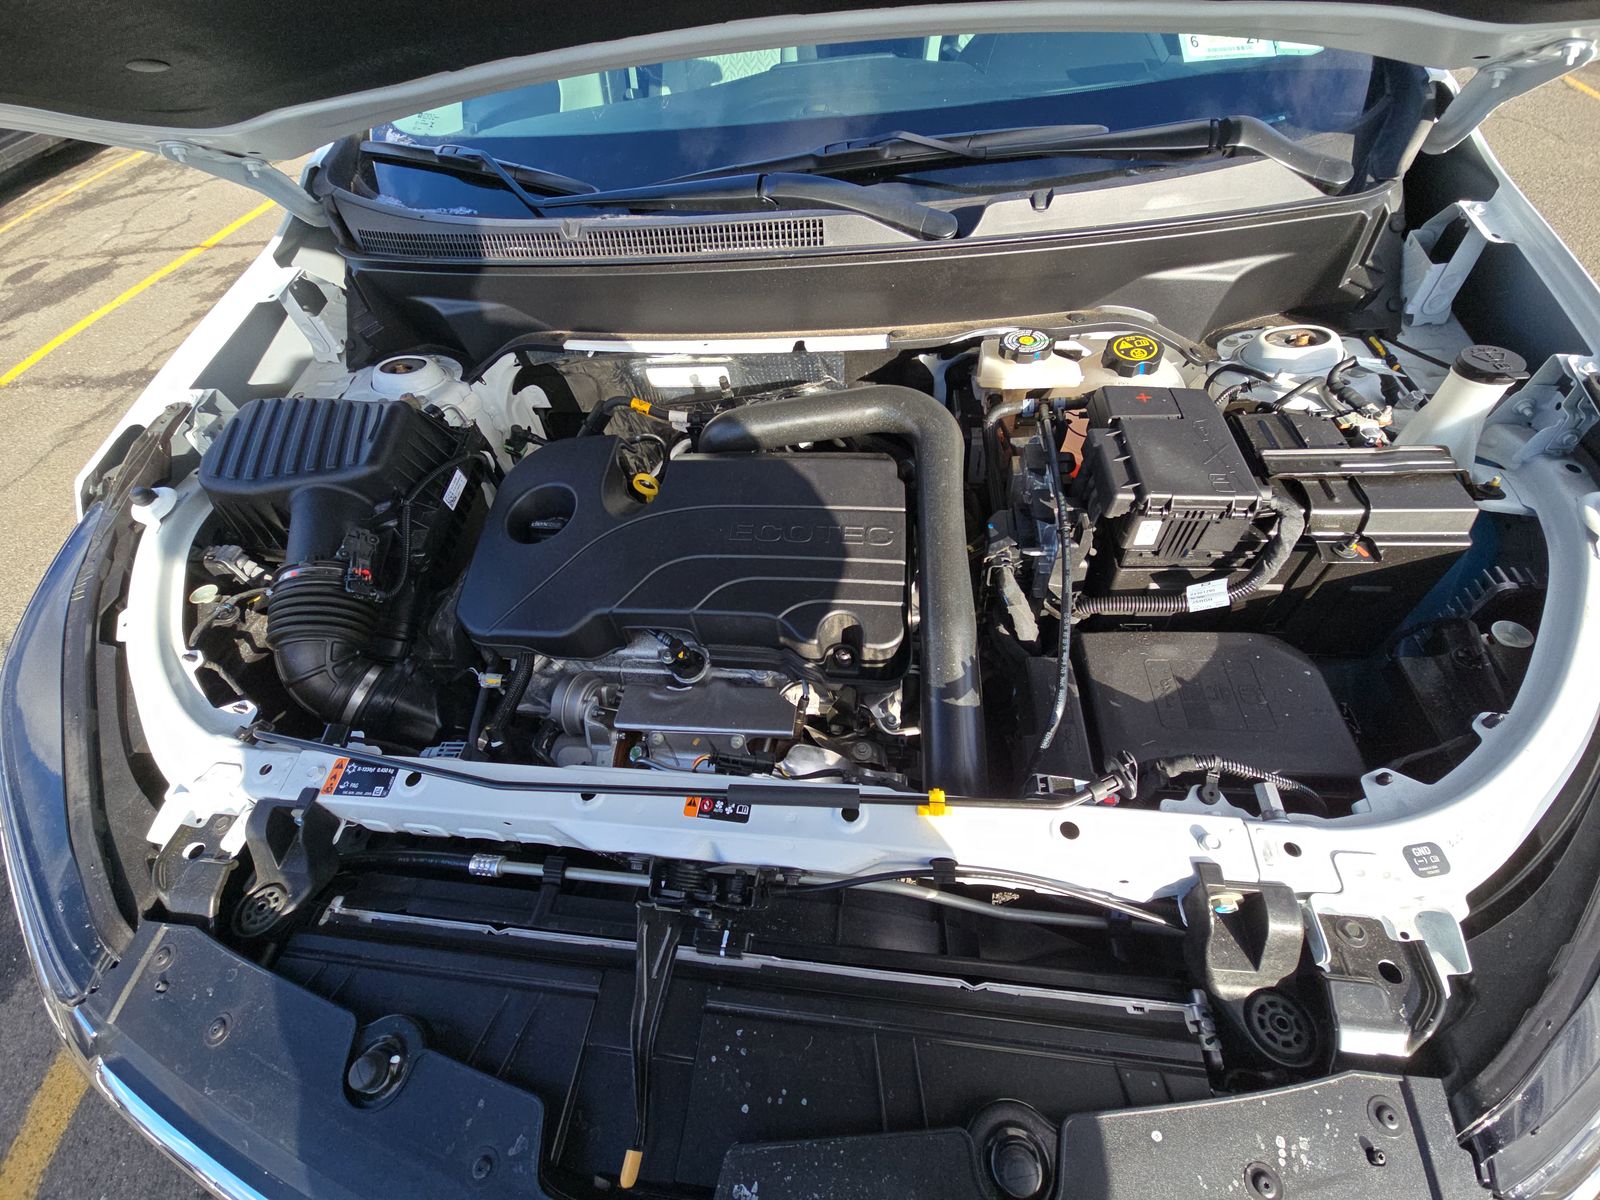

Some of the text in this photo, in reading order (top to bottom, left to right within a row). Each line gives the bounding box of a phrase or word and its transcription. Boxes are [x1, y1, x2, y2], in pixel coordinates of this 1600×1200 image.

[1190, 35, 1199, 48] 6
[728, 524, 896, 547] ECOTEC
[1411, 845, 1432, 857] GND
